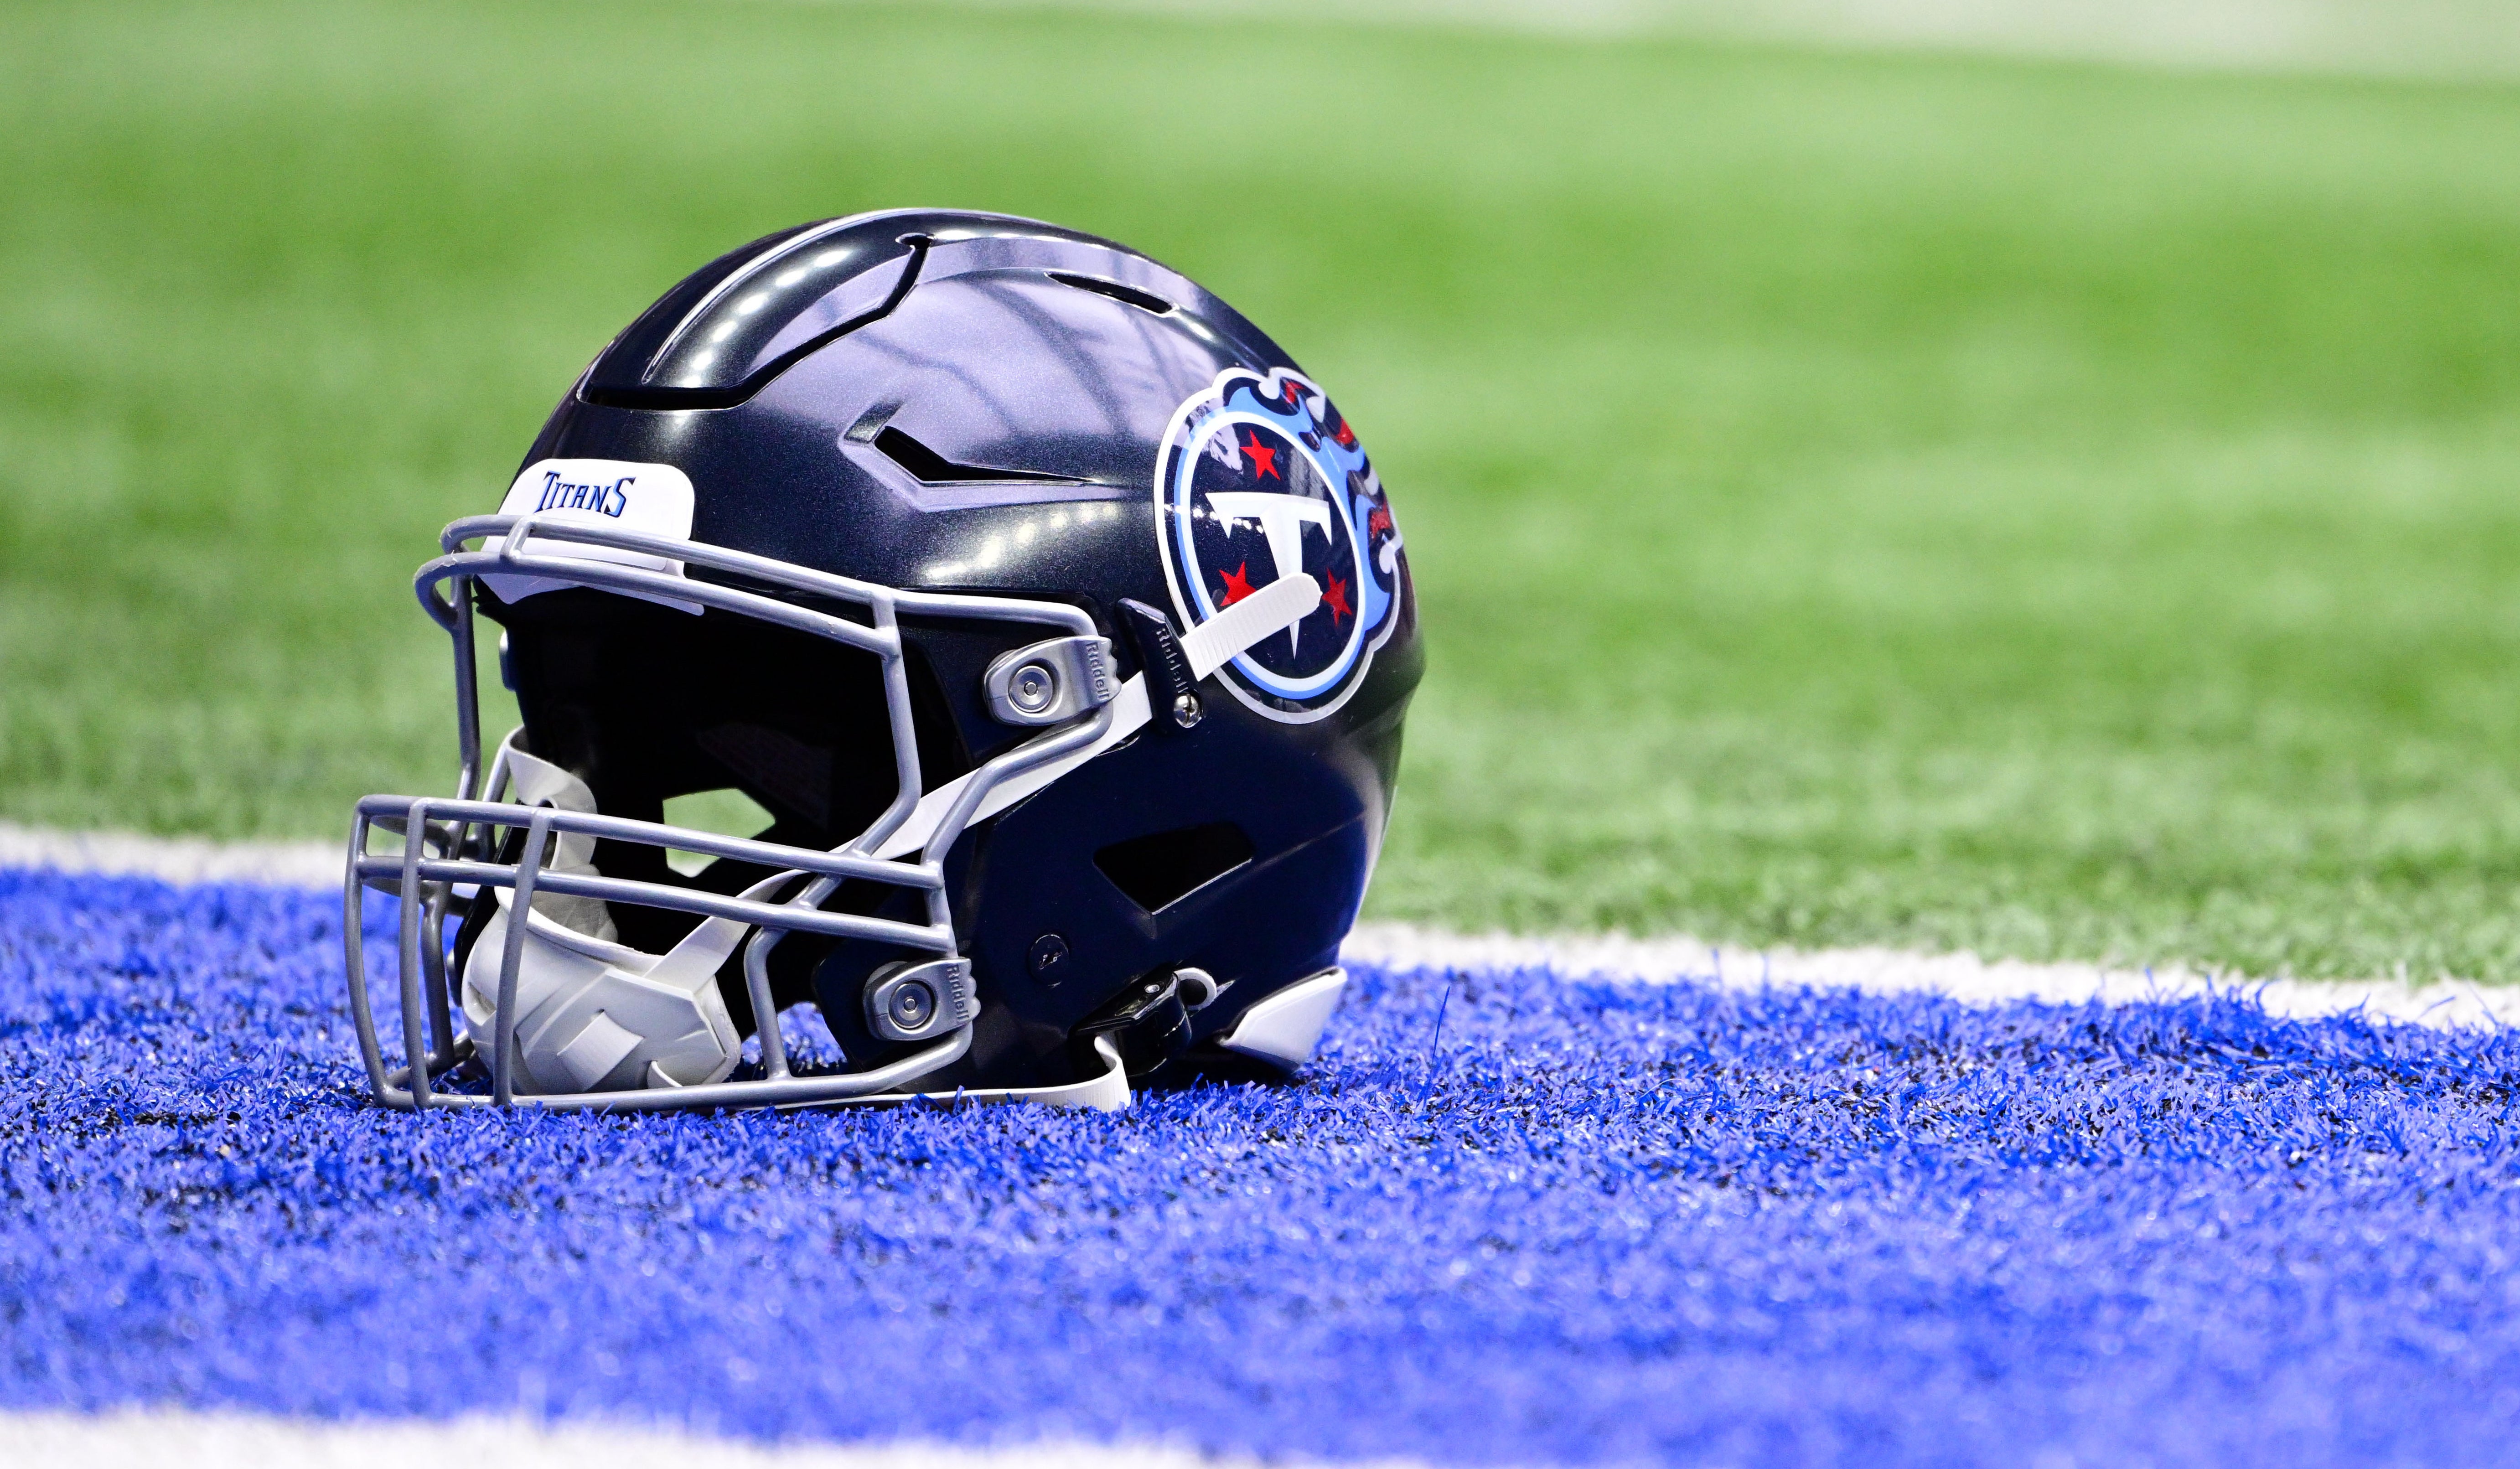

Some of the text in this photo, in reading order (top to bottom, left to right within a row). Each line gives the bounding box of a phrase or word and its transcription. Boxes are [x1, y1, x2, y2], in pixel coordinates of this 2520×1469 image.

[533, 470, 636, 518] TITANS
[1205, 492, 1332, 660] T
[1086, 642, 1110, 701] Riddell
[1156, 628, 1189, 693] Riddell
[947, 964, 970, 1022] Riddell
